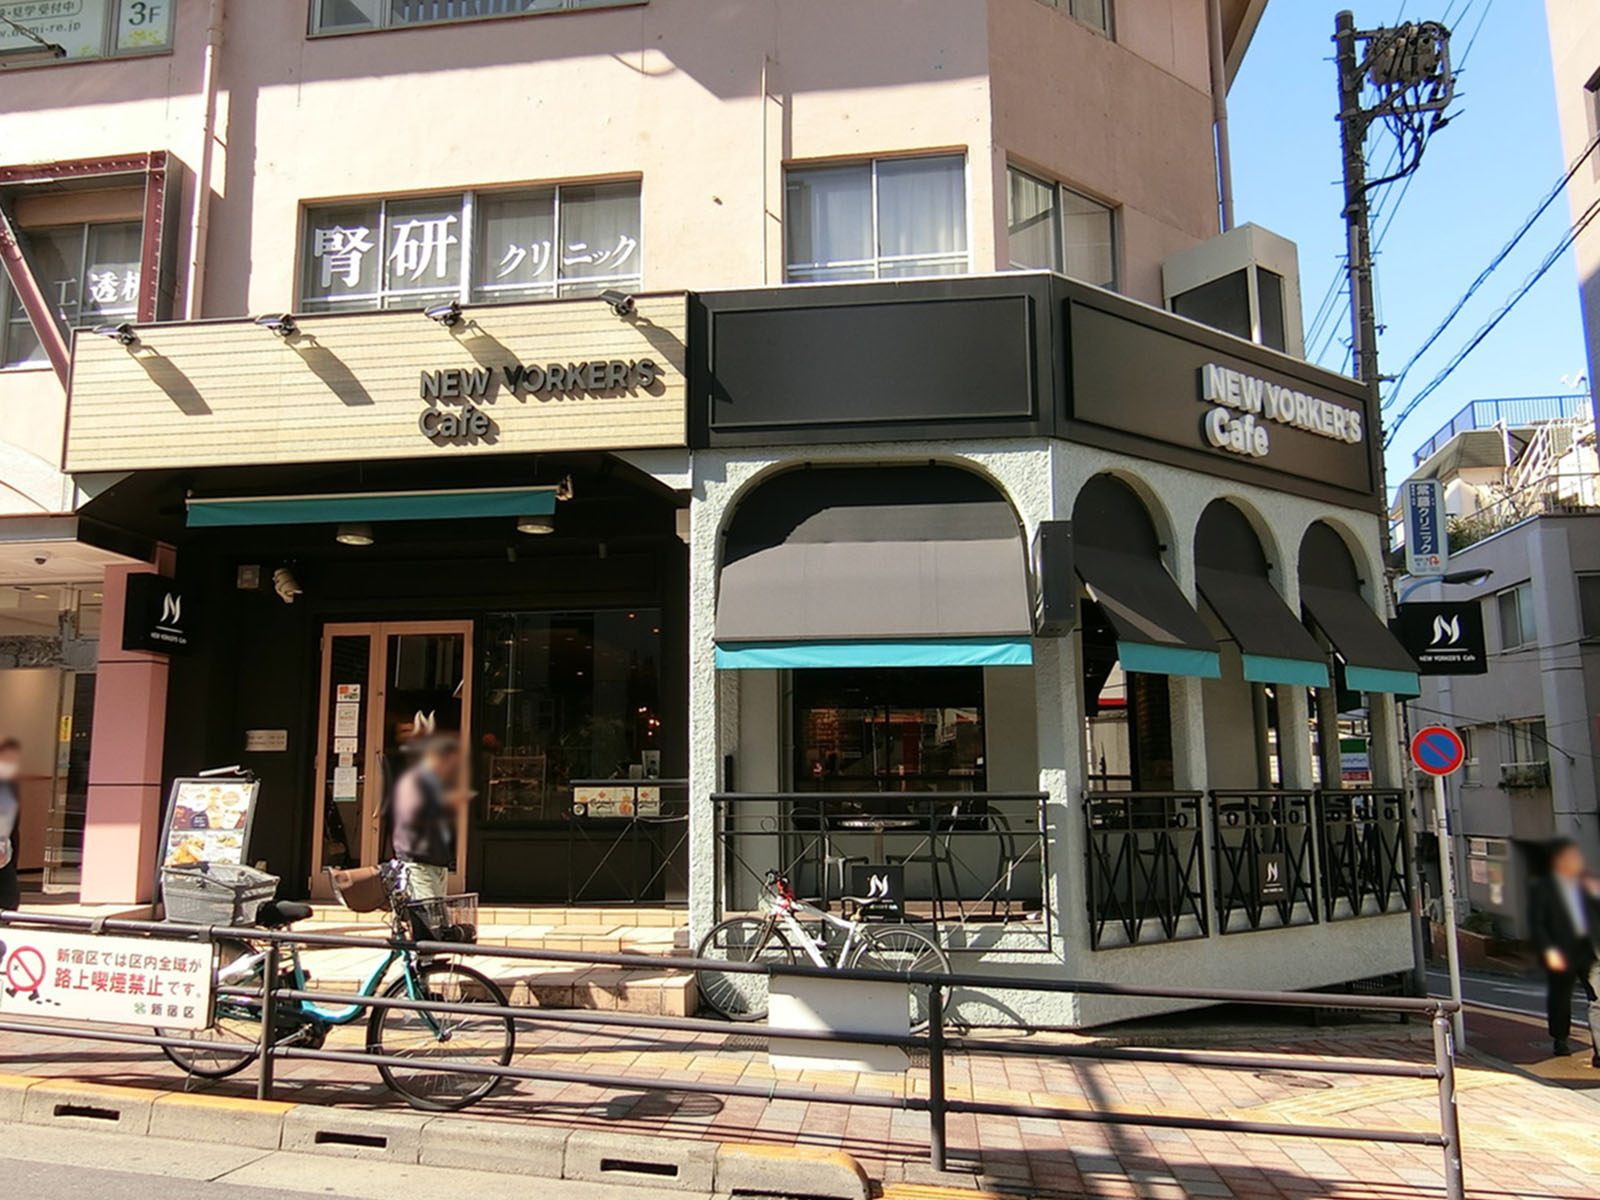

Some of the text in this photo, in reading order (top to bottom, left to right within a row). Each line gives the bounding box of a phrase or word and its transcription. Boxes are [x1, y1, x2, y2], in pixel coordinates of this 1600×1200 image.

[128, 1, 161, 26] 3F
[314, 214, 638, 289] 腎研 クリニック
[420, 357, 656, 399] NEW YORKER'S
[419, 403, 490, 438] Cafe
[1202, 363, 1362, 444] NEW YORKER'S
[1205, 406, 1270, 458] Cafe
[57, 948, 202, 974] 新宿区では区内全域が
[54, 967, 201, 999] 路上喫煙禁止です。
[151, 1002, 196, 1020] 新宿区
